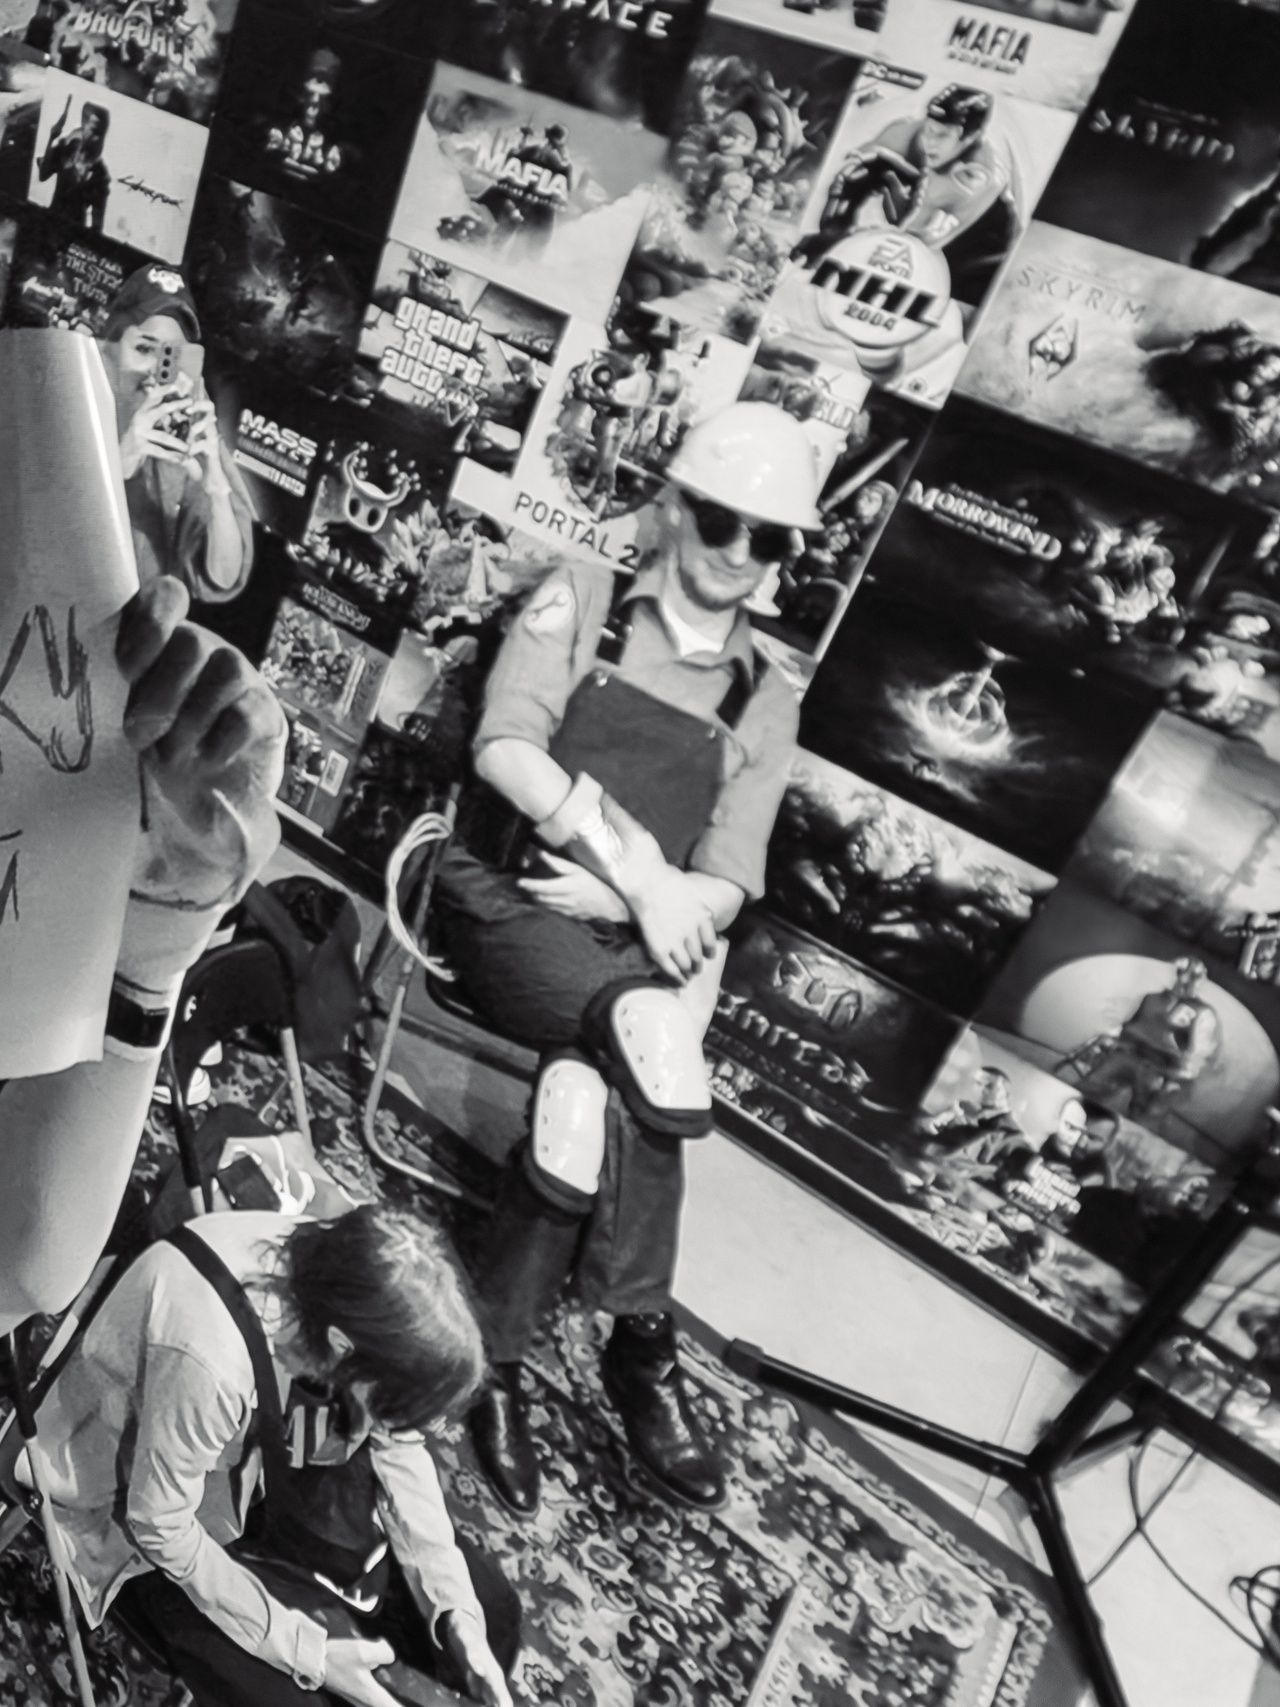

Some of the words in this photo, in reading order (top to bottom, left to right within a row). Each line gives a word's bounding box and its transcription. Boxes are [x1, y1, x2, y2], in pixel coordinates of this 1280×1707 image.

[948, 15, 1032, 66] MAFIA
[476, 140, 569, 201] MAFIA
[810, 256, 940, 328] NHL
[1017, 265, 1147, 325] SKYRIM
[239, 408, 319, 459] MASS
[514, 490, 612, 559] PORTAL
[618, 543, 640, 571] 2
